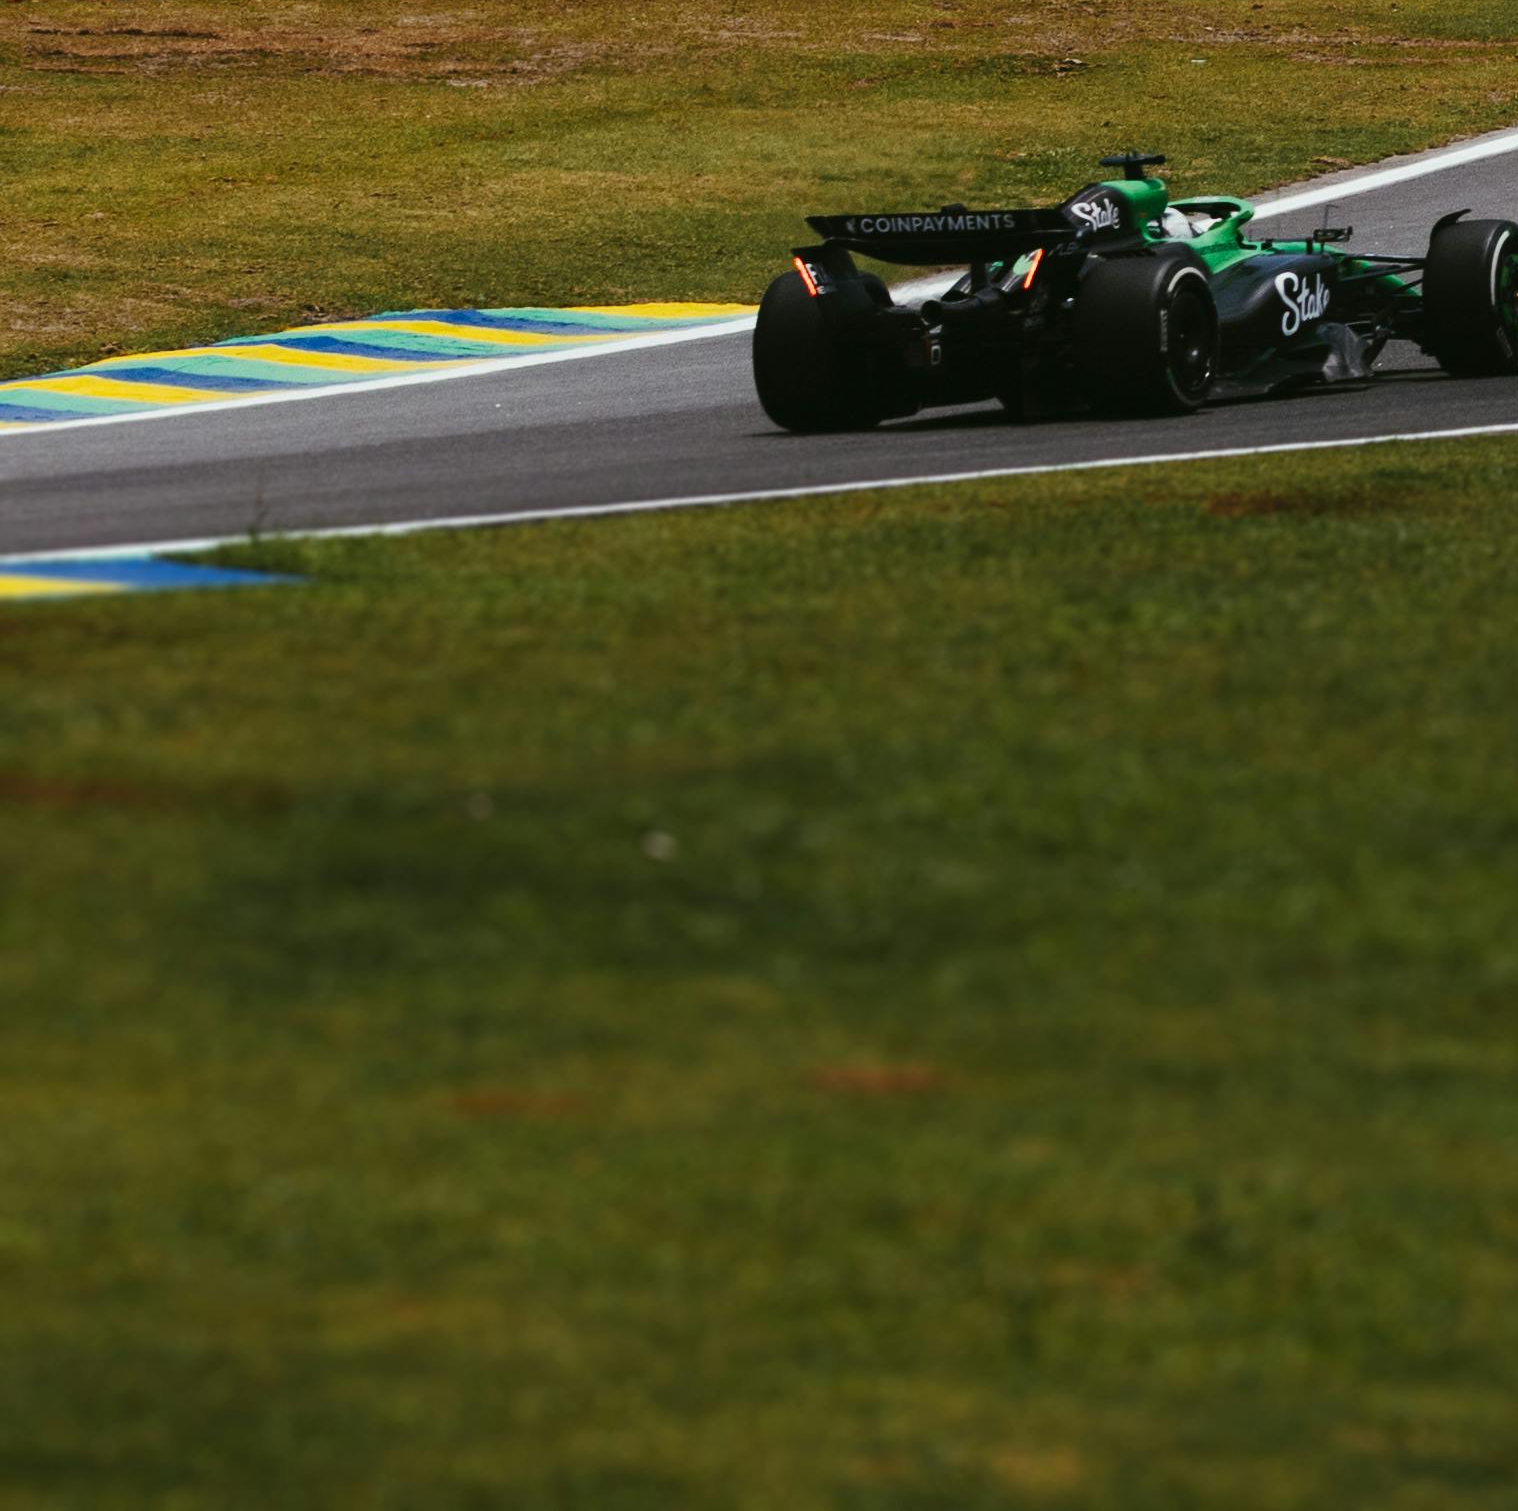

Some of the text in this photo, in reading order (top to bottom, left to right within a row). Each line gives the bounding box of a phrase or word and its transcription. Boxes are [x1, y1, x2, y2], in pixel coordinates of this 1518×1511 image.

[860, 213, 1016, 234] COINPAYMENTS
[1071, 198, 1121, 232] Stake
[1274, 272, 1331, 337] Stake
